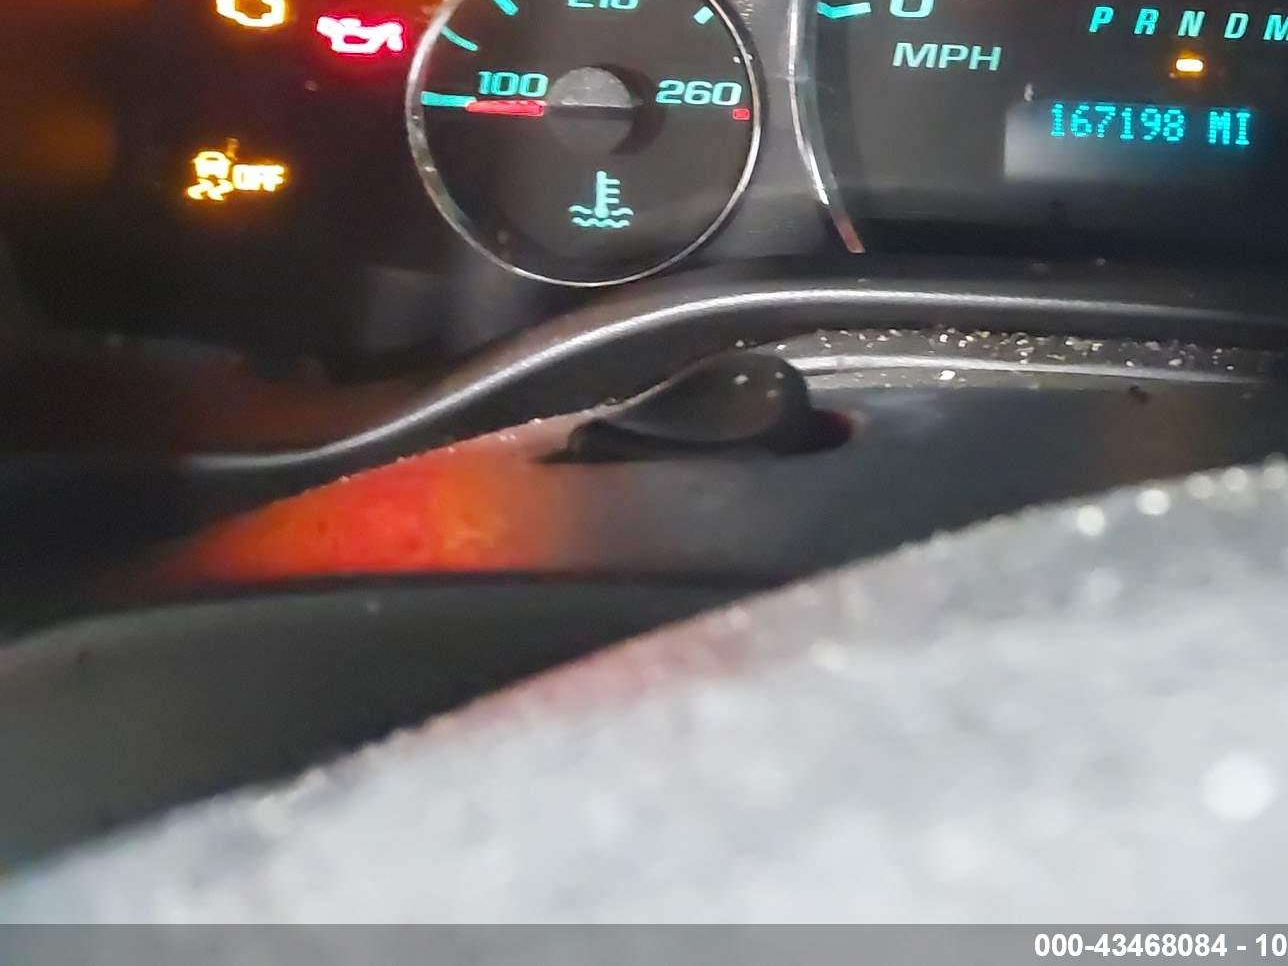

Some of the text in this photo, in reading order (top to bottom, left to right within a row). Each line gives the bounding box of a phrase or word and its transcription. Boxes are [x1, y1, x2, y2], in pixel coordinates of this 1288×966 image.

[1089, 7, 1113, 33] P
[1134, 8, 1160, 35] R
[1177, 10, 1205, 37] N
[1223, 12, 1249, 40] D
[892, 42, 1001, 71] MPH
[478, 71, 548, 98] 100
[655, 79, 742, 106] 260
[1050, 103, 1251, 145] 167198 MI
[232, 165, 285, 191] OFF
